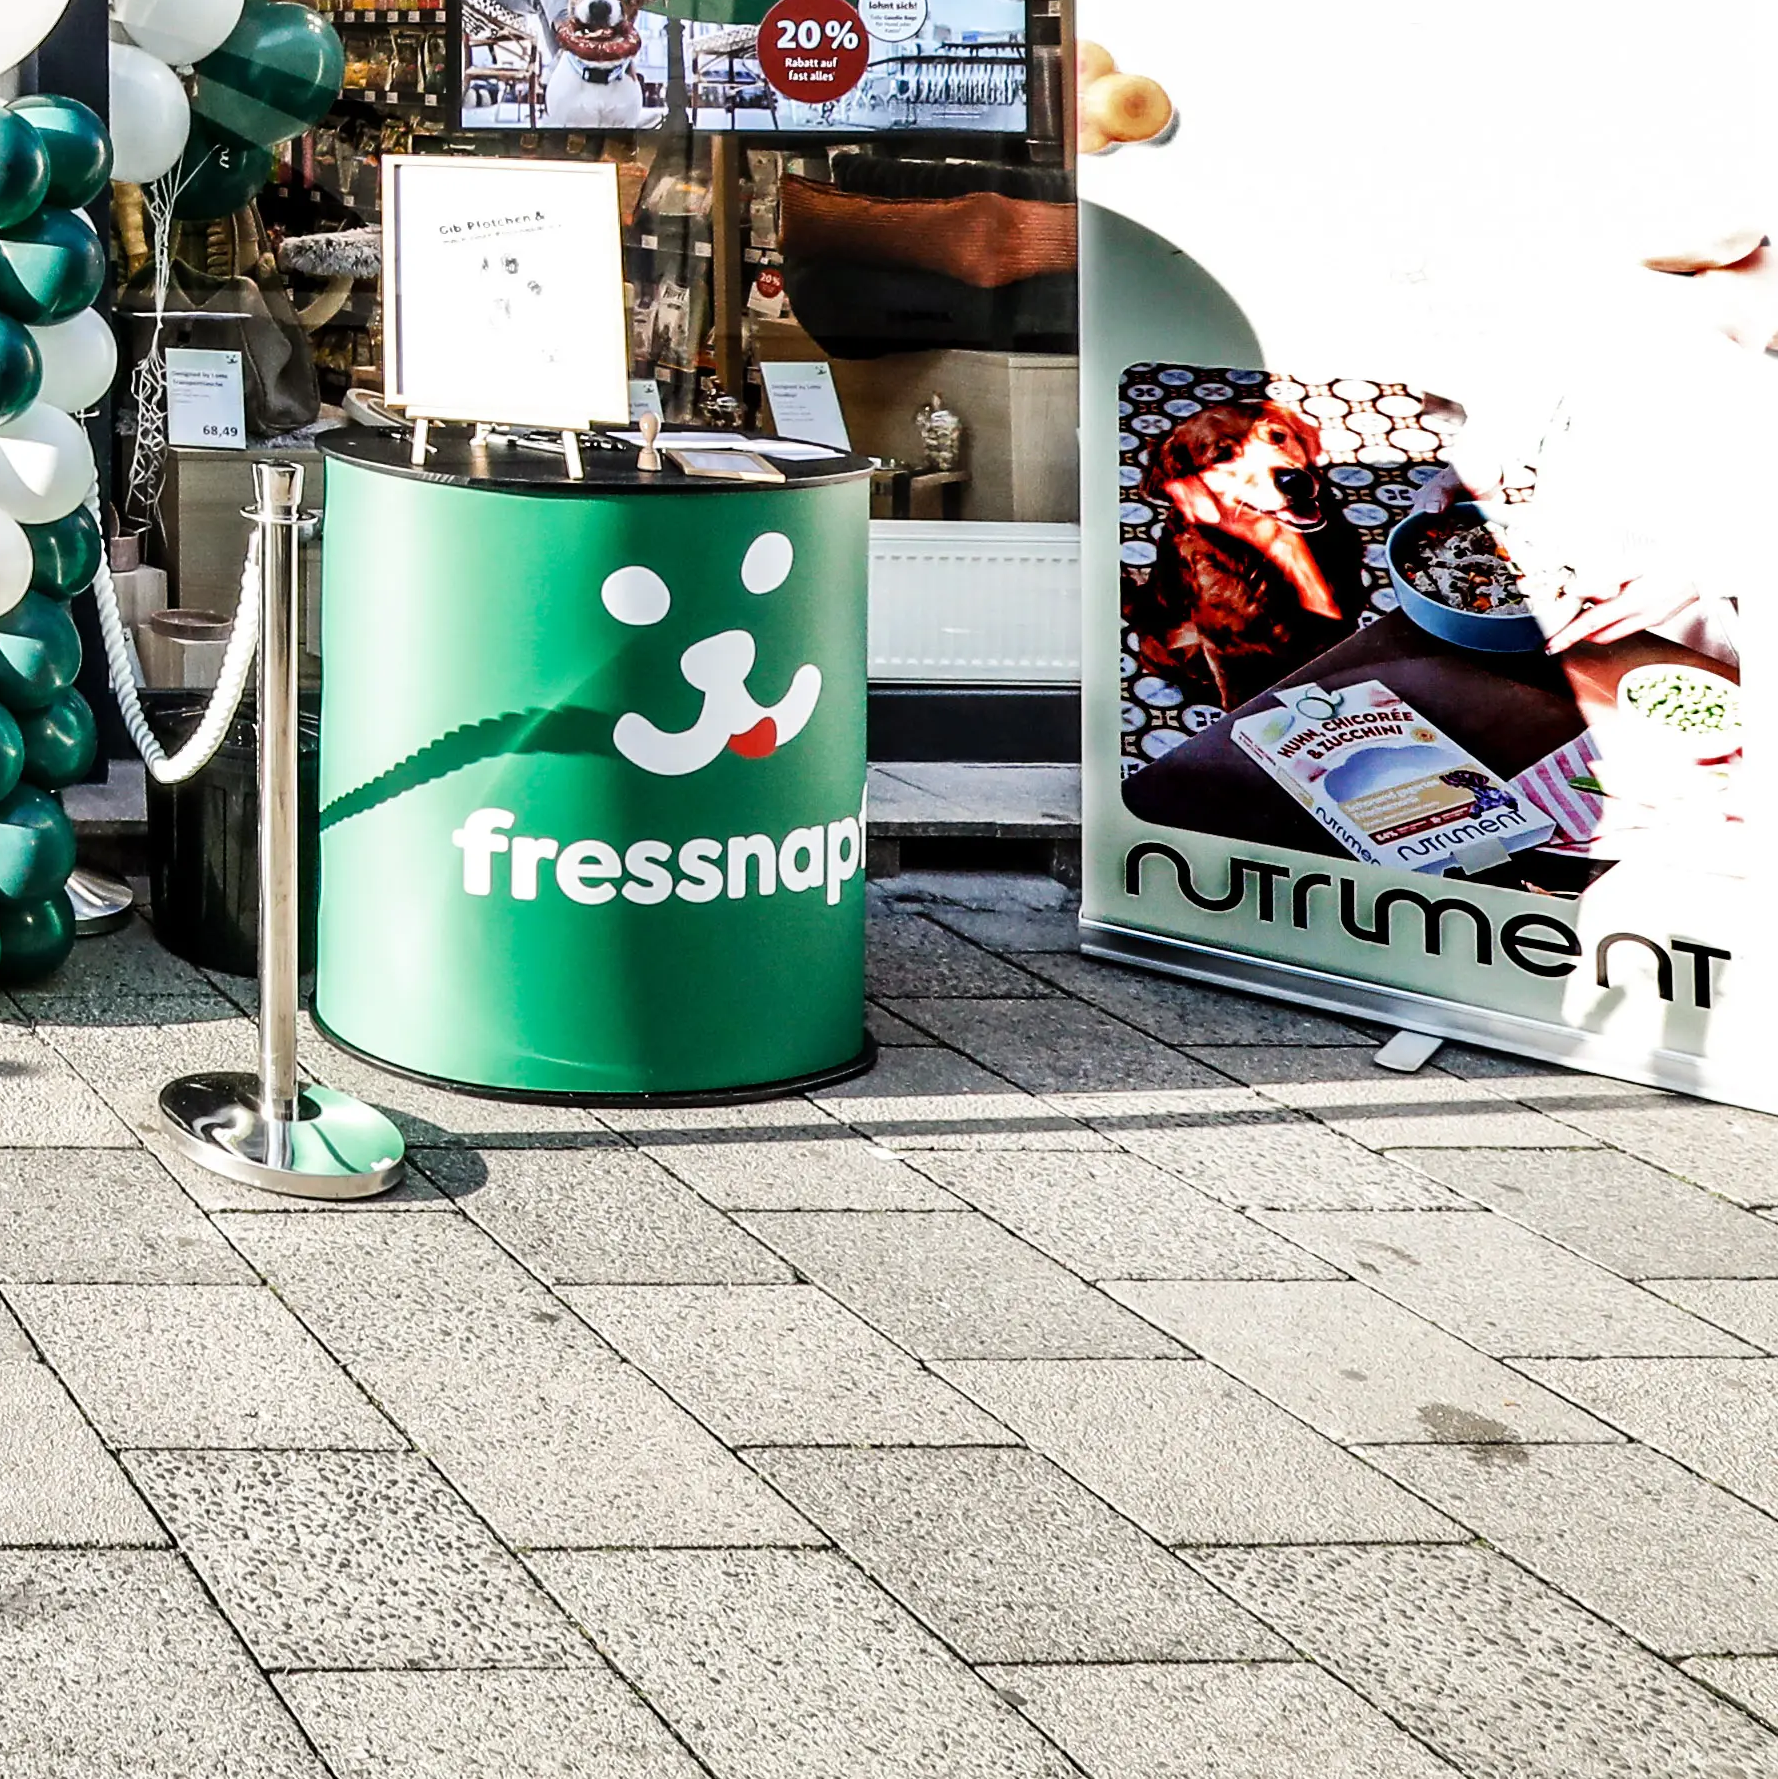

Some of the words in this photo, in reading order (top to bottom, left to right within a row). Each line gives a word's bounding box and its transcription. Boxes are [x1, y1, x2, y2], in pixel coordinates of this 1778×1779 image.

[785, 57, 819, 68] Rabatt
[820, 56, 838, 68] auf
[788, 70, 808, 82] fast
[202, 424, 239, 439] 68,49
[1276, 723, 1326, 759] HUHN,
[1320, 708, 1415, 733] CHICORÉE
[1324, 724, 1404, 753] ZUCCHINI
